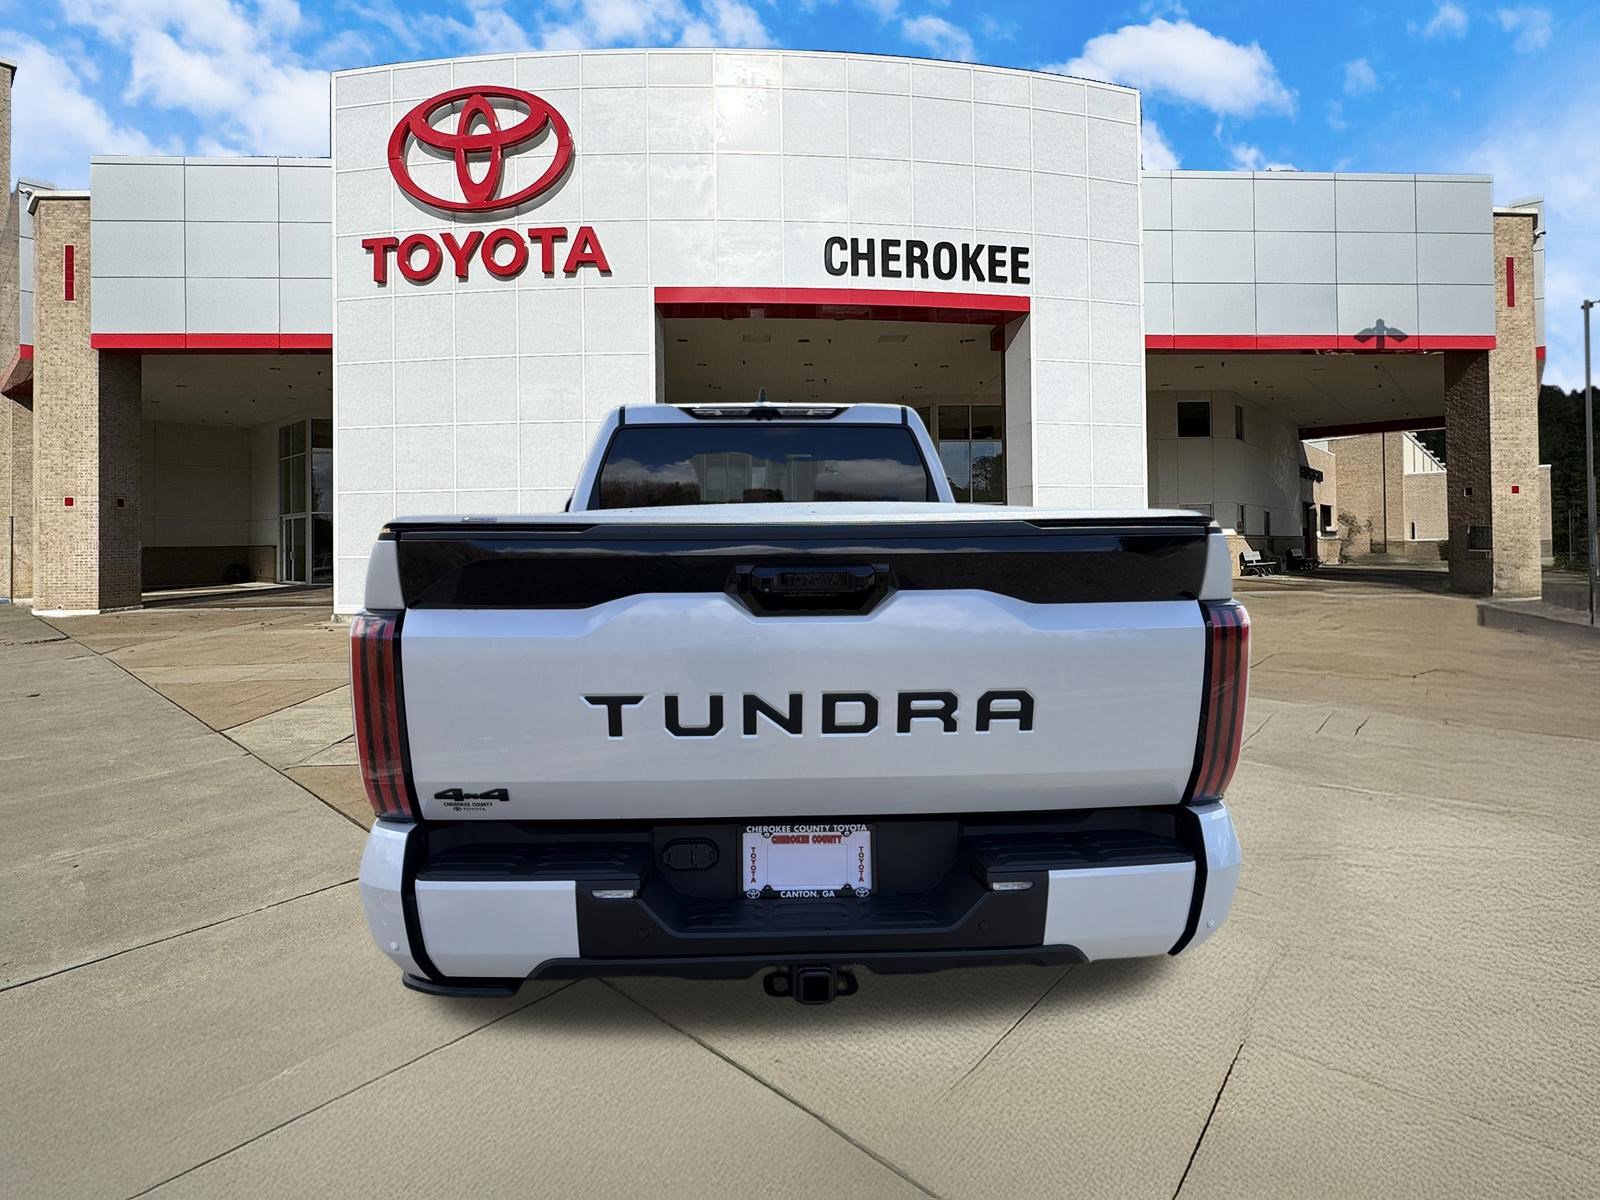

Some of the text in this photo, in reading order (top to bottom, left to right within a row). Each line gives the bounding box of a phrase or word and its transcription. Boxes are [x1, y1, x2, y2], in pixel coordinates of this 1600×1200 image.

[362, 226, 612, 287] TOYOTA
[824, 236, 1031, 285] CHEROKEE
[784, 573, 841, 586] TOYOTA
[581, 689, 1036, 740] TUNDRA
[746, 825, 791, 833] CHEROKEE
[771, 835, 842, 844] CHEROKEE COUNTY
[780, 890, 820, 898] CANTON,
